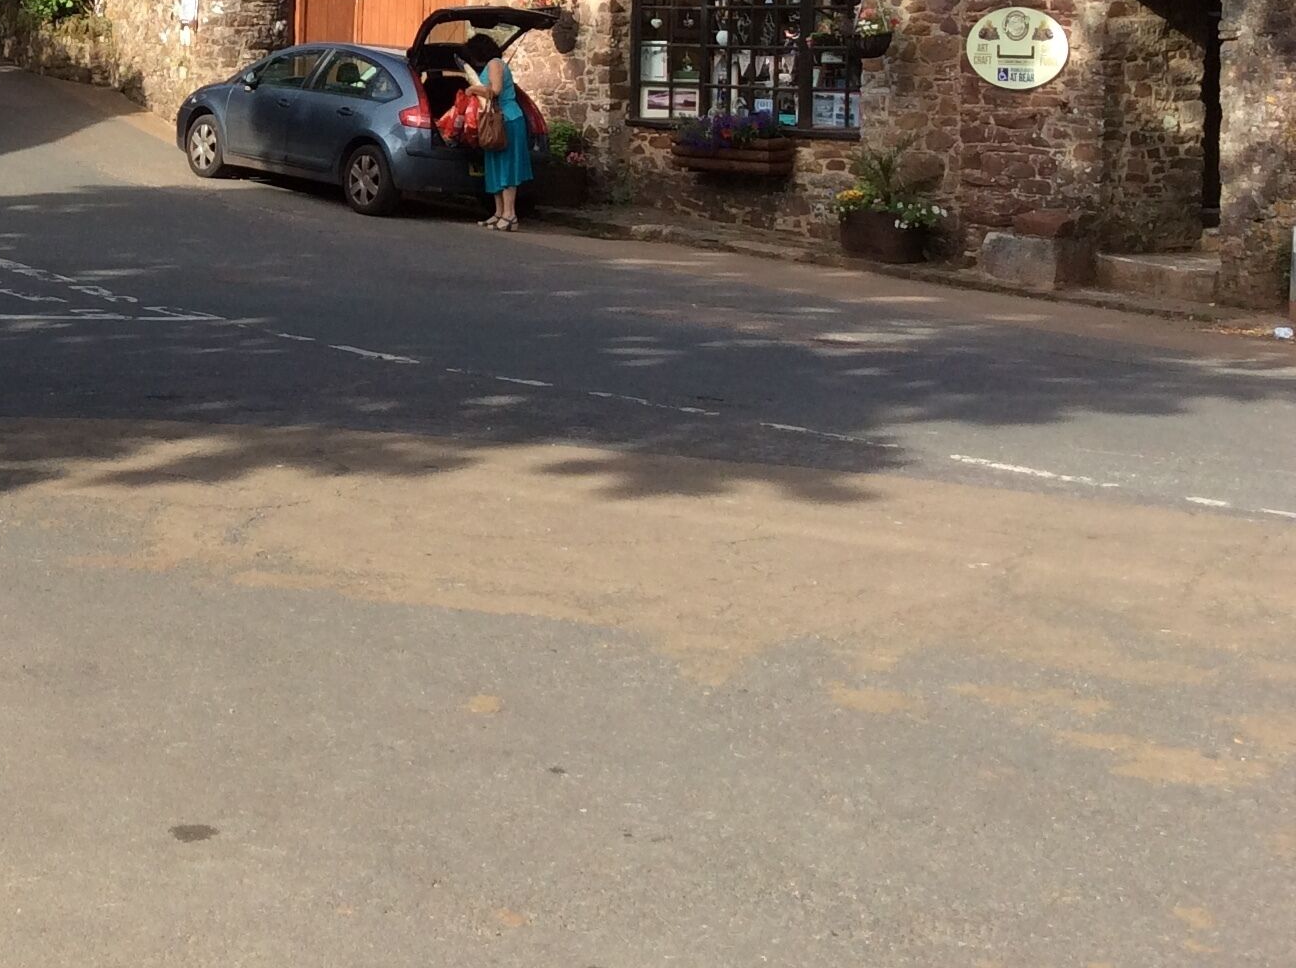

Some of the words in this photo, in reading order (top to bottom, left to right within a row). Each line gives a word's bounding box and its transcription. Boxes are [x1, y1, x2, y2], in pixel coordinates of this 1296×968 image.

[977, 43, 988, 52] ART
[973, 56, 992, 65] CRAFT
[1010, 72, 1017, 82] AT
